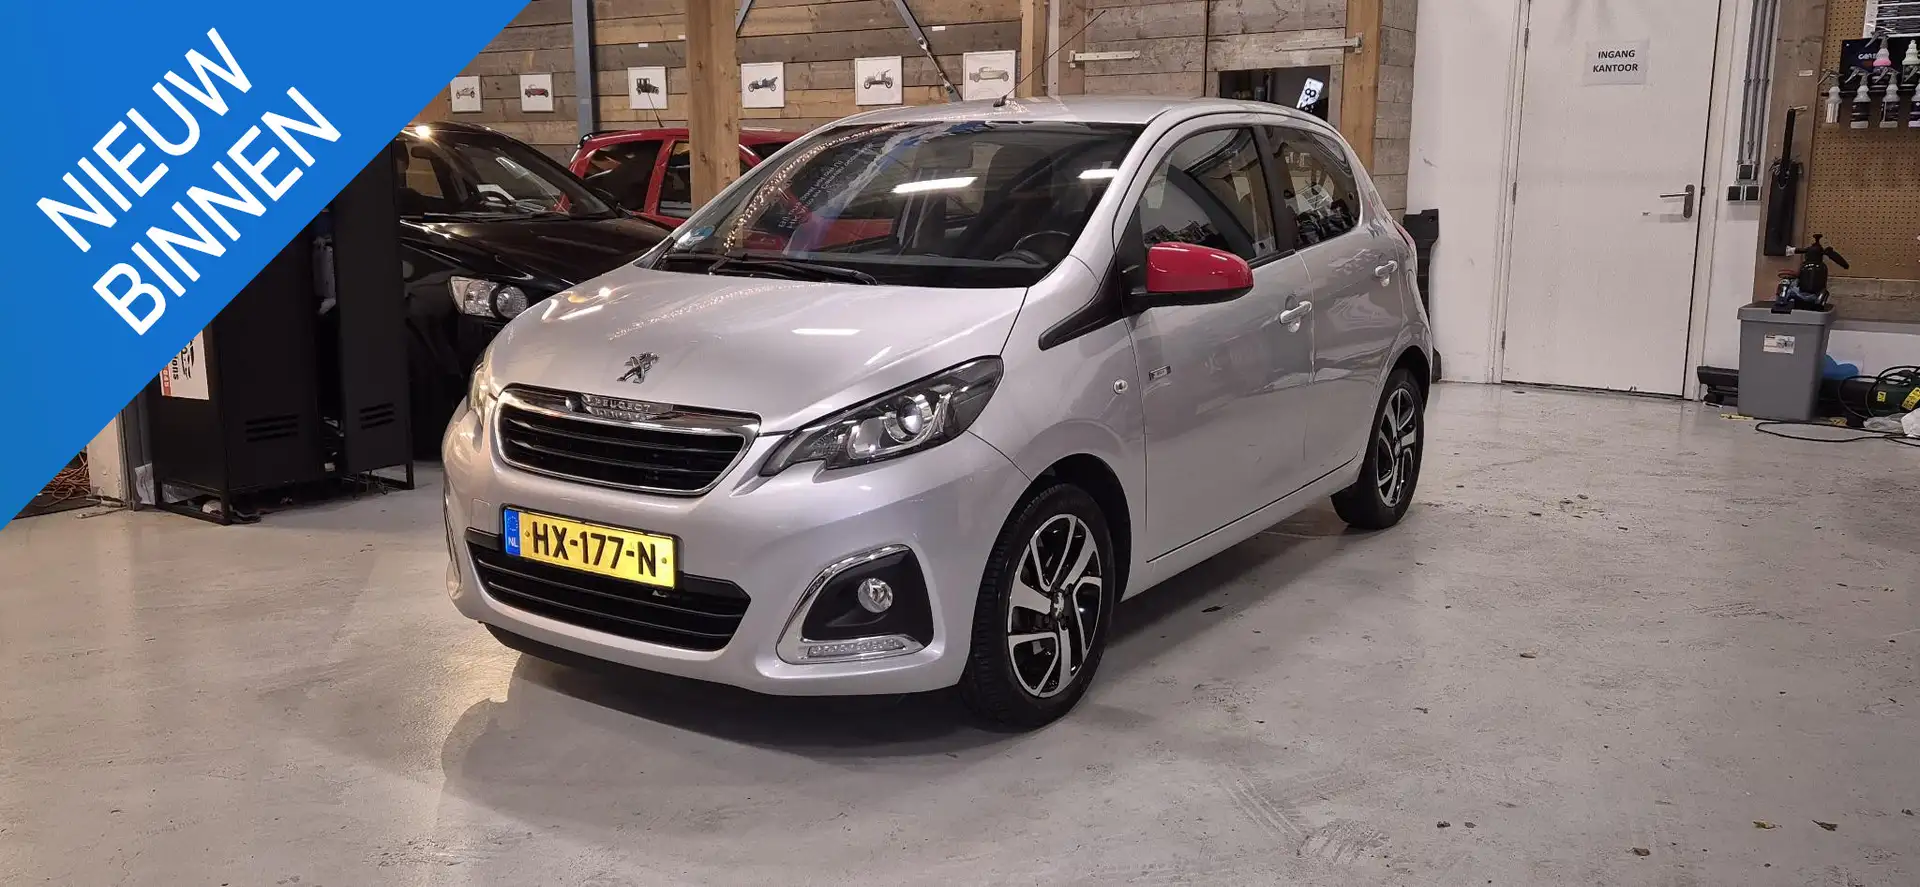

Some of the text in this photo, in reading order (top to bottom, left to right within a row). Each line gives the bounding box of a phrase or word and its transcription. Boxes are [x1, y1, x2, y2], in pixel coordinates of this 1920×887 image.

[1598, 49, 1636, 59] INGANG
[1593, 63, 1639, 73] KANTOOR
[595, 397, 651, 412] PEUGEOT
[508, 537, 519, 548] NL
[532, 521, 657, 577] HX-177-N
